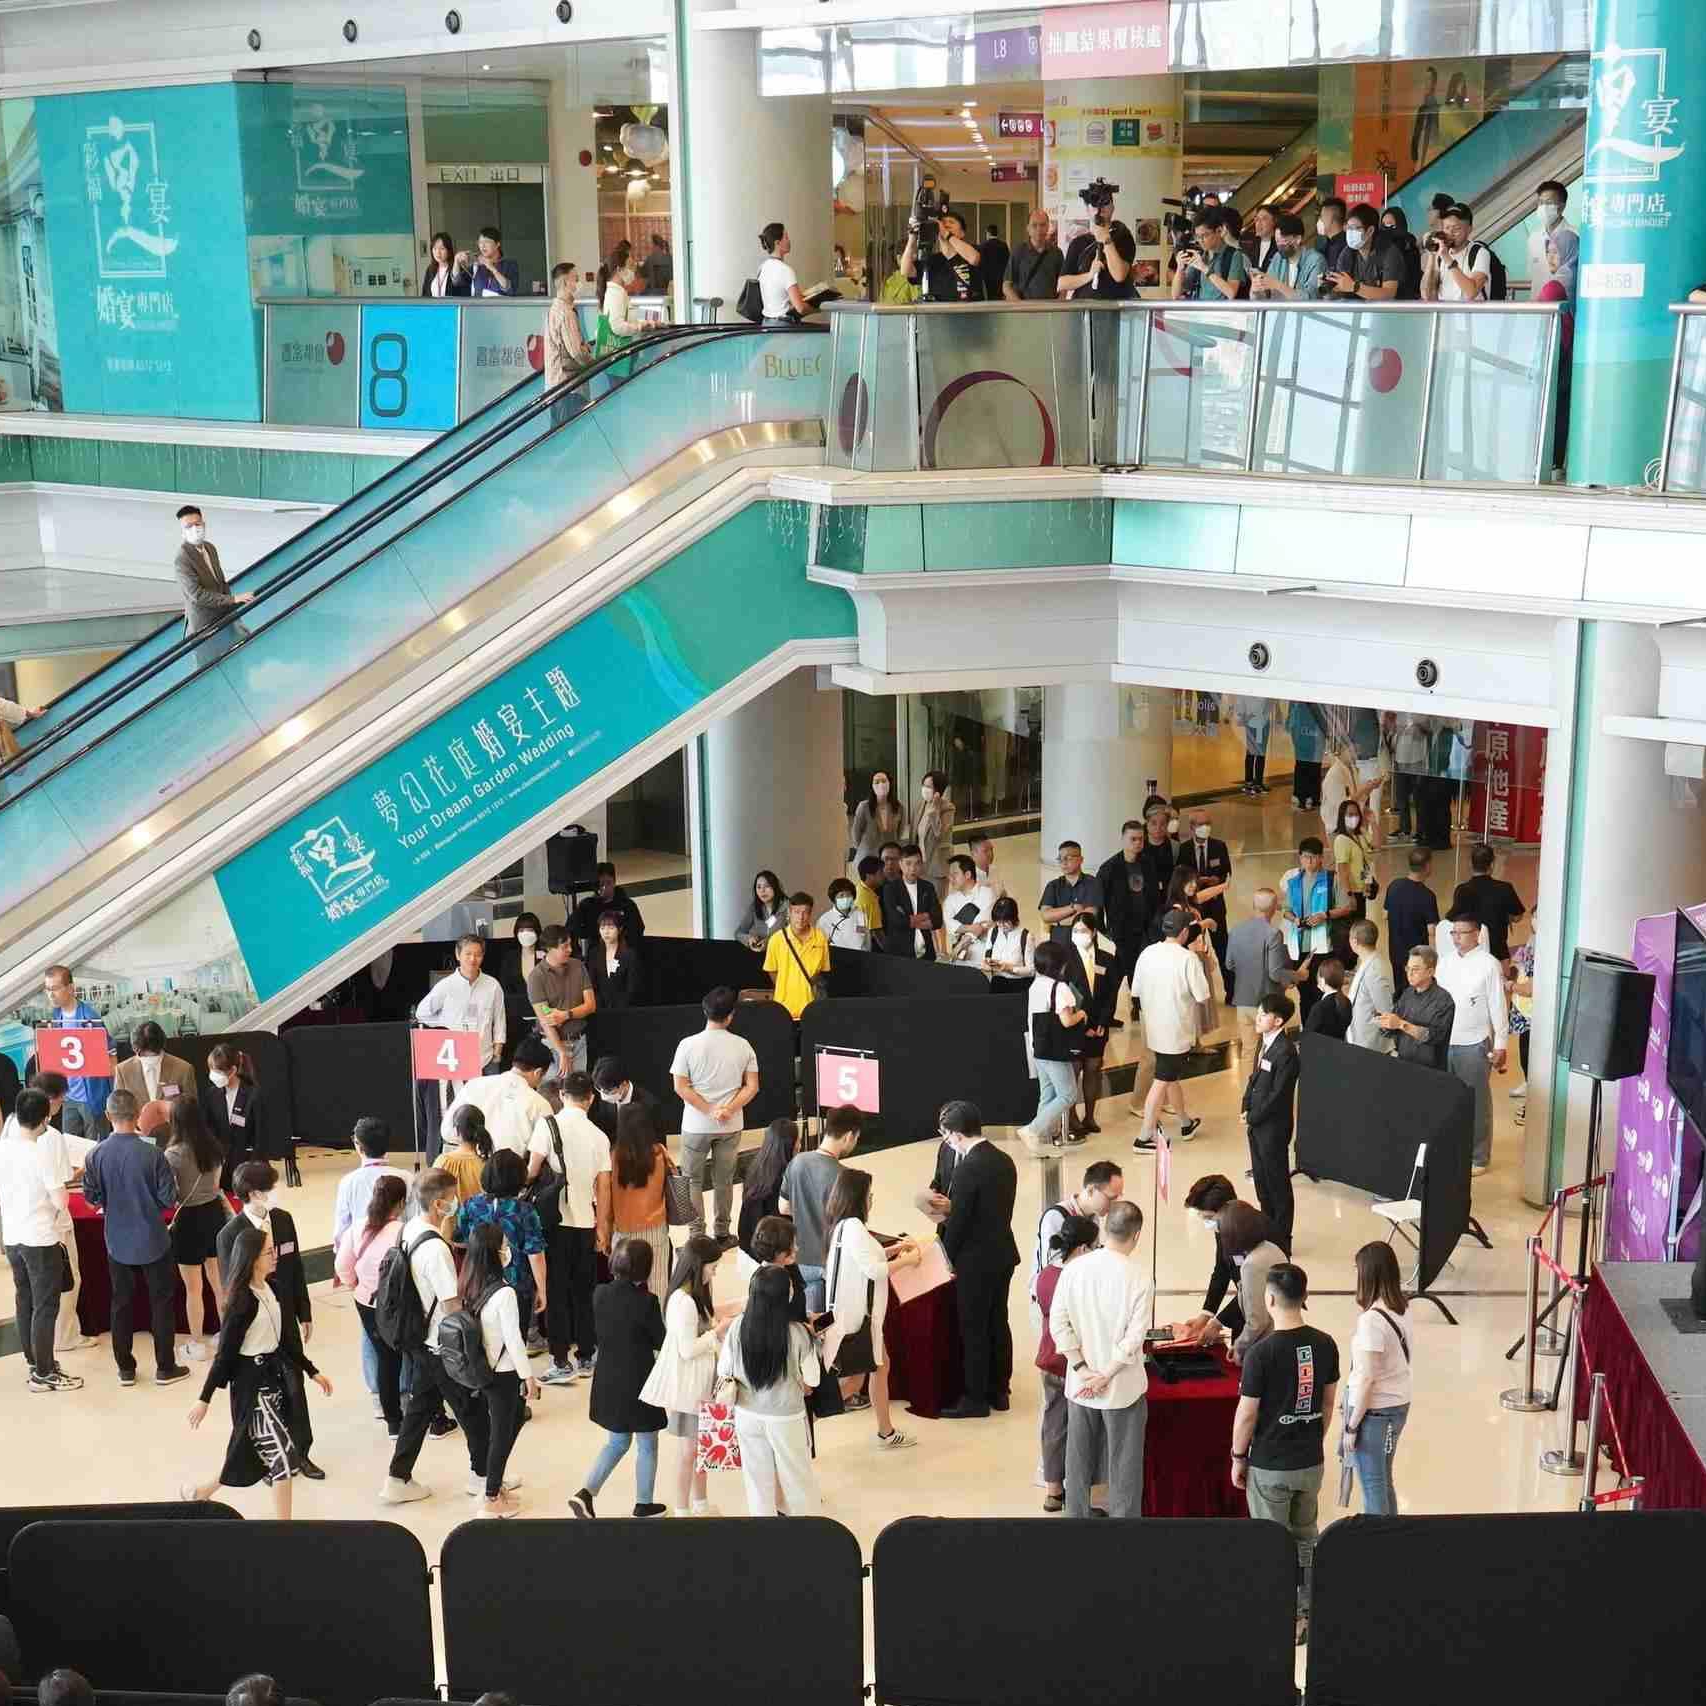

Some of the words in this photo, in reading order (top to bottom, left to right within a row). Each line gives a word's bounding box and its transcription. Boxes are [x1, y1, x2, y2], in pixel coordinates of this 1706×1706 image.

[441, 168, 477, 182] EXIT
[490, 168, 520, 182] 出口
[370, 333, 408, 418] 8
[372, 664, 581, 832] 夢幻花庭婚宴主題
[398, 829, 429, 851] Your
[431, 795, 472, 829] Dream
[473, 763, 519, 798] Garden
[518, 722, 575, 767] Wedding
[59, 1036, 85, 1069] 3
[436, 1039, 460, 1072] 4
[836, 1065, 859, 1102] 5
